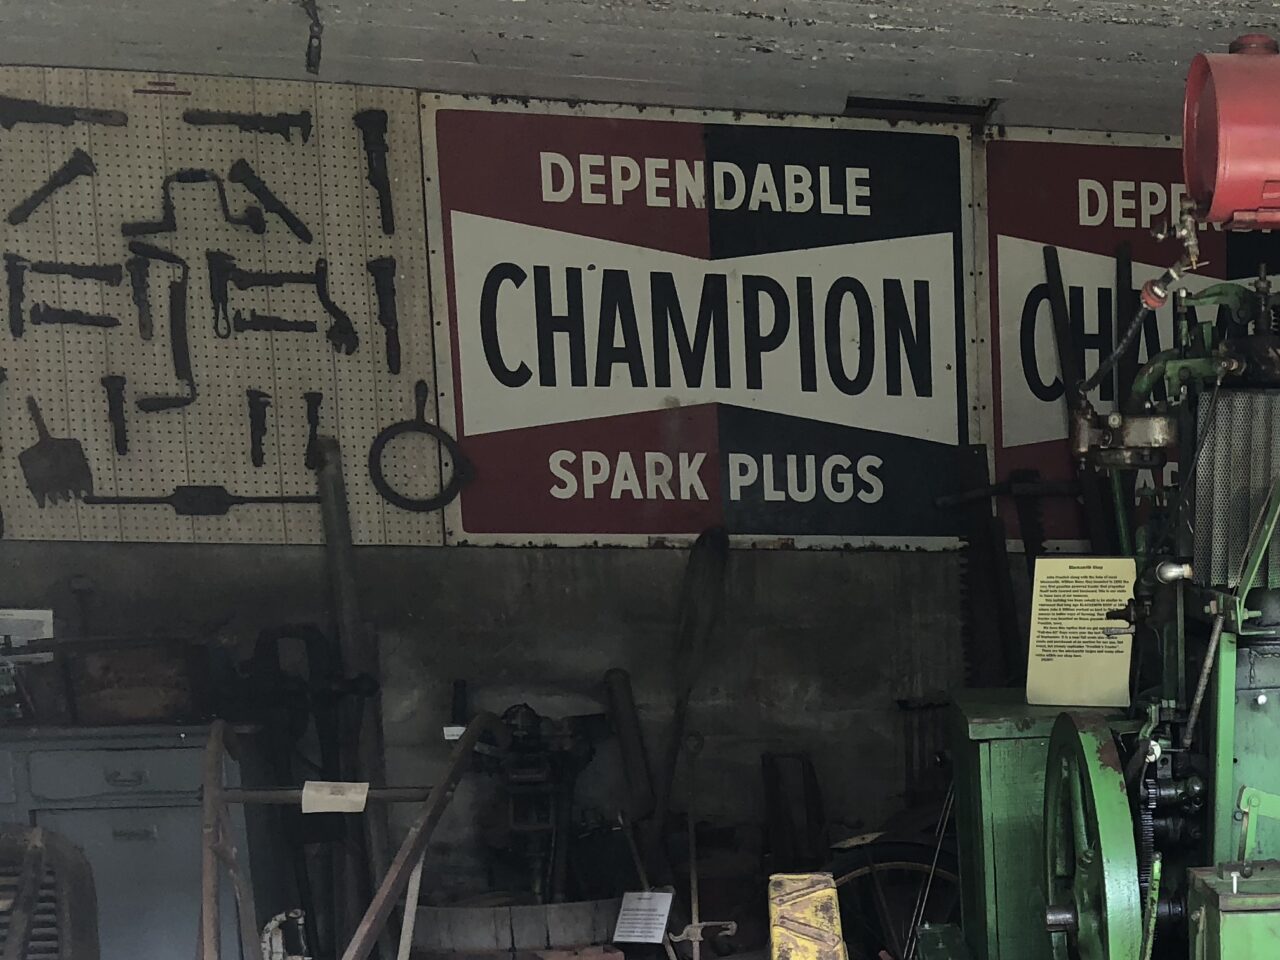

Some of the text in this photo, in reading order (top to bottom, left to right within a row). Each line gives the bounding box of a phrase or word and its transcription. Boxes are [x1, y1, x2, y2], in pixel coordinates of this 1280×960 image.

[539, 151, 871, 216] DEPENDABLE
[479, 262, 933, 398] CHAMPION
[548, 449, 884, 504] SPARK PLUGS
